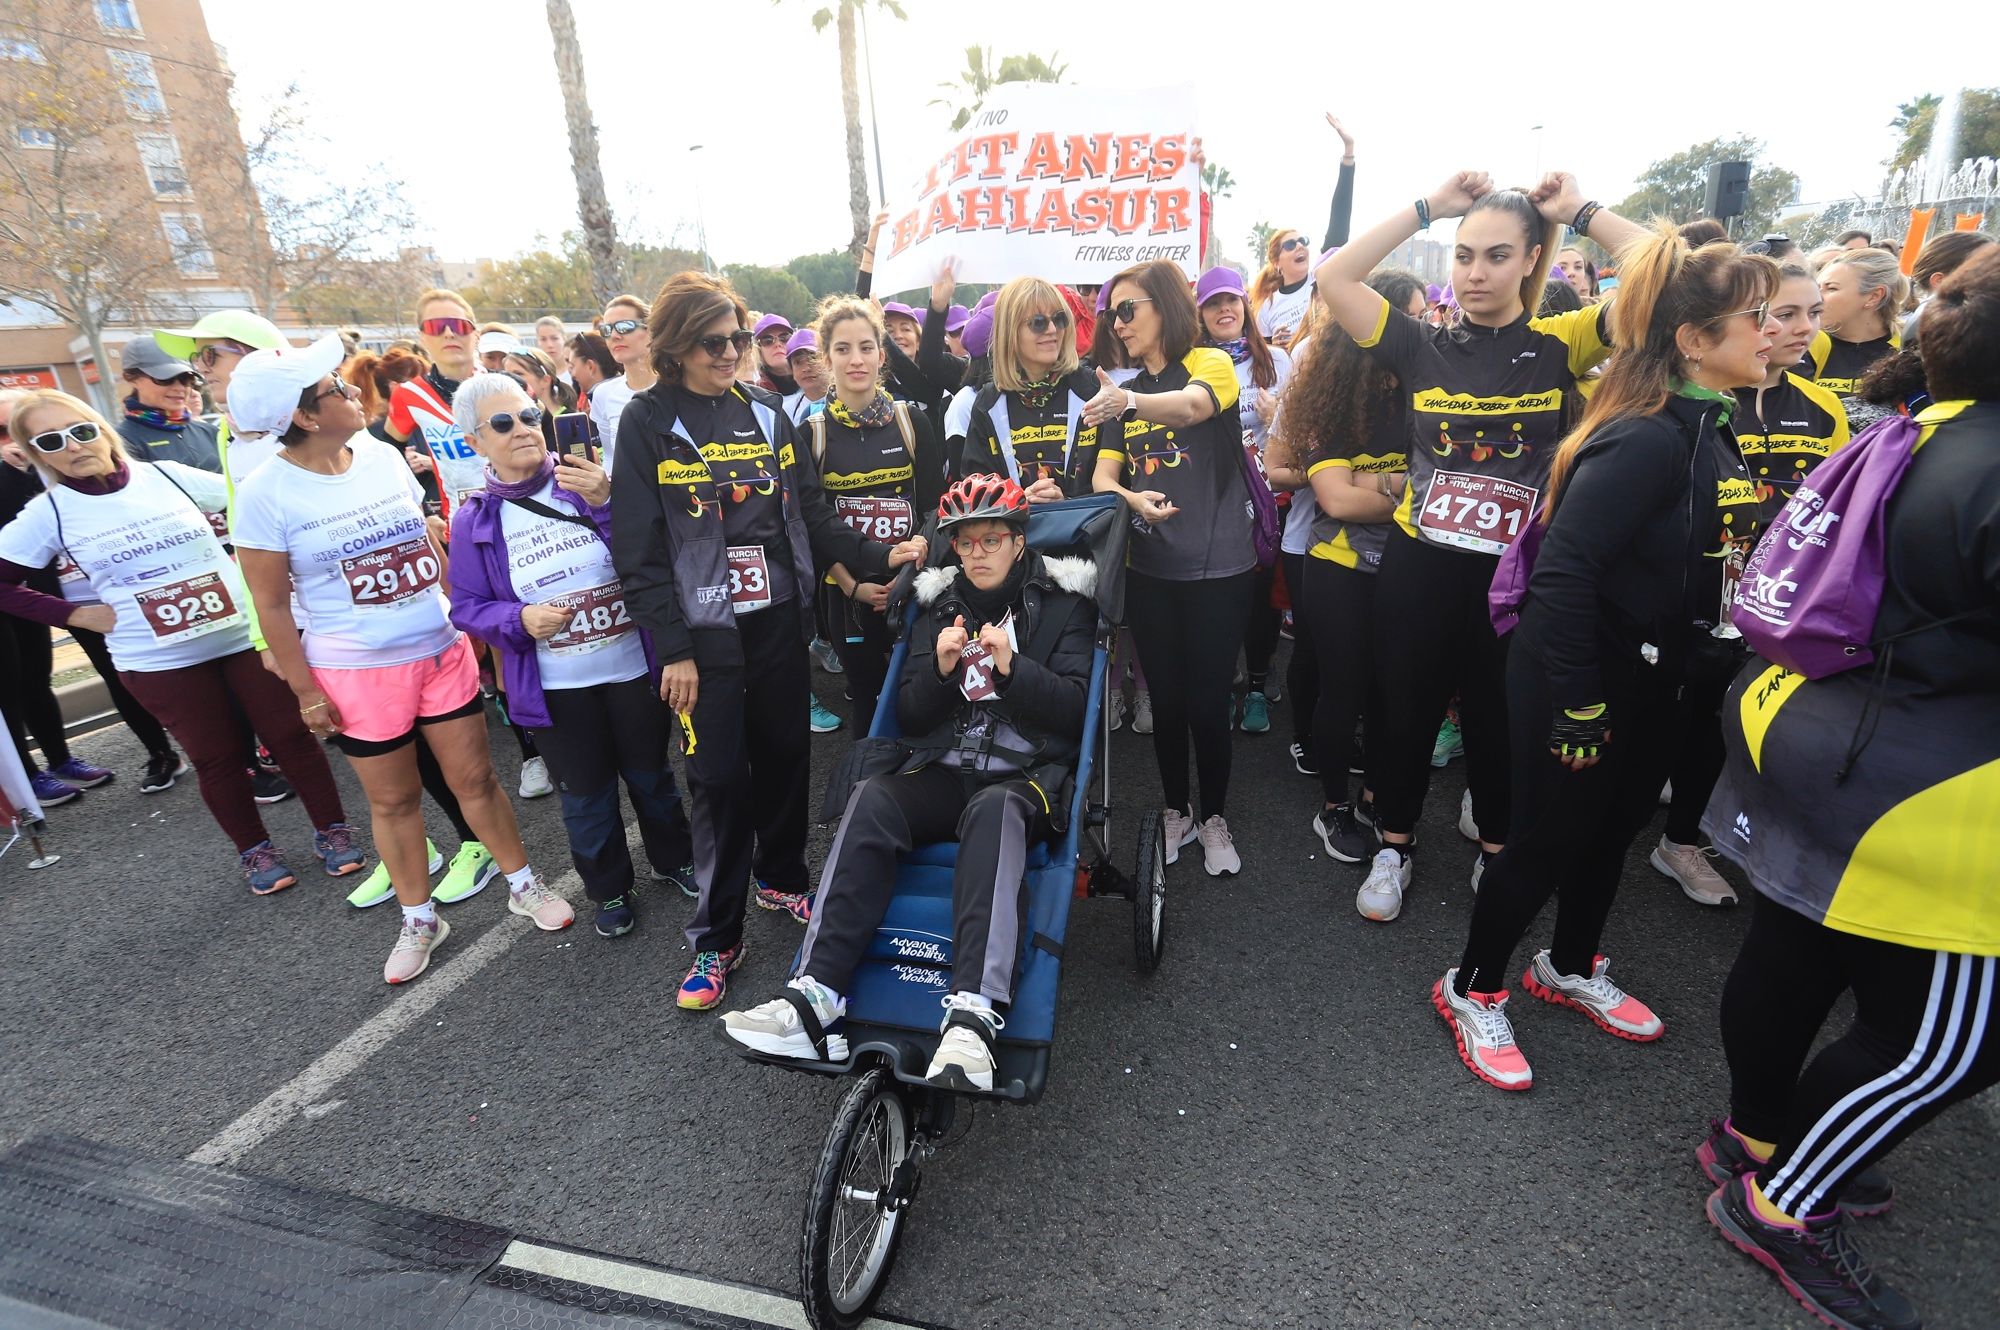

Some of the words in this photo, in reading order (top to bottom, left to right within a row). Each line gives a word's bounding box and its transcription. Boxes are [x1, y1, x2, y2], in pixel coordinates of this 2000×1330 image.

[919, 131, 1187, 201] TITANES
[887, 186, 1192, 261] BAHIASUR
[1075, 245, 1134, 261] FITNESS
[1135, 245, 1191, 262] CENTER
[1424, 399, 1472, 410] ZANCADAS
[1472, 402, 1511, 411] SOBRE
[1453, 480, 1486, 494] mujer
[1494, 483, 1530, 499] MURCIA
[322, 509, 358, 525] CARRERA
[359, 506, 370, 515] DE
[371, 502, 381, 510] LA
[850, 504, 874, 514] mujer
[1426, 493, 1522, 536] 4791
[327, 525, 359, 541] POR
[1458, 527, 1482, 537] MARIA
[111, 526, 208, 564] COMPAÑERAS
[361, 552, 393, 567] mujer
[353, 556, 437, 600] 2910
[393, 590, 414, 600] LOLITA
[592, 584, 622, 597] MURCIA
[156, 591, 224, 626] 928
[553, 601, 632, 640] 482
[584, 633, 606, 641] CHISPA
[1756, 669, 1793, 710] ZAN
[890, 938, 939, 950] Advance
[898, 947, 945, 961] Mobility
[891, 965, 941, 976] Advance
[899, 973, 946, 986] Mobility
